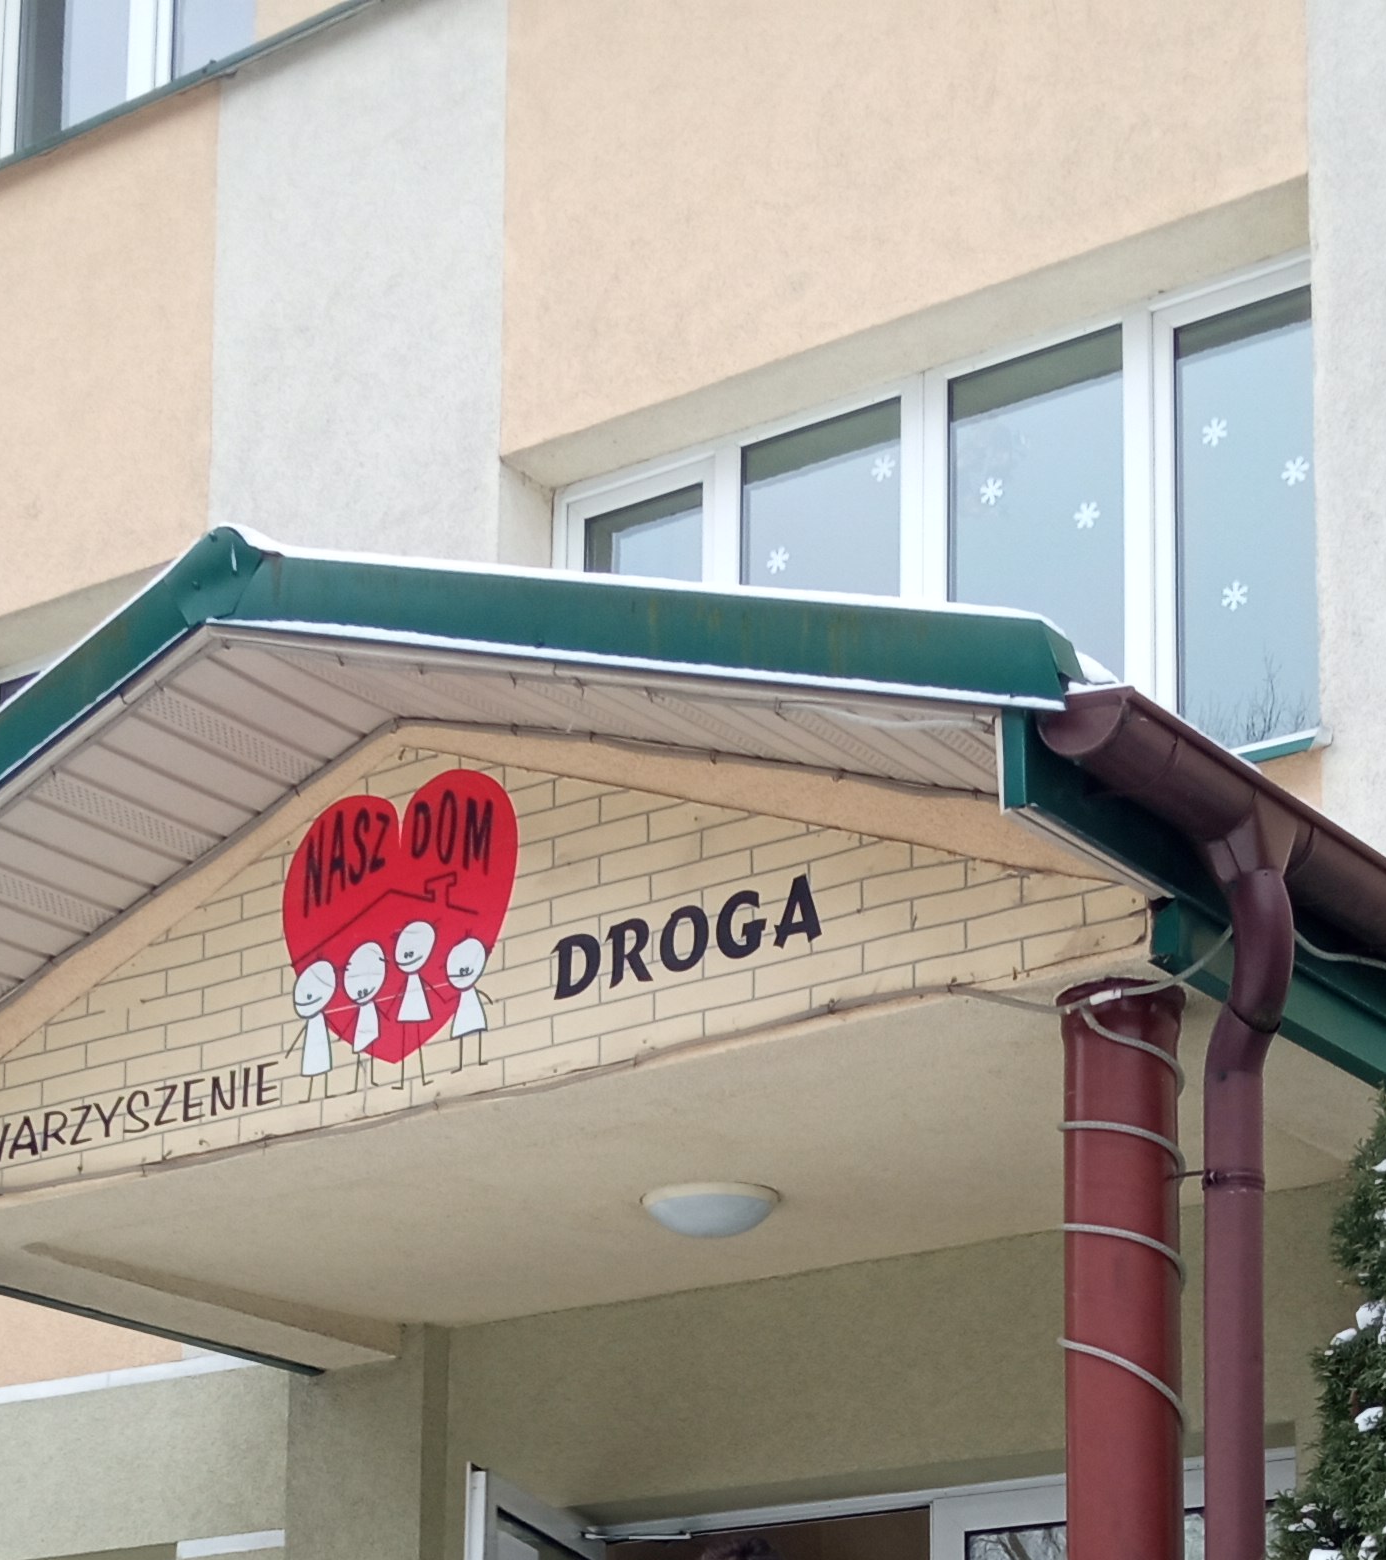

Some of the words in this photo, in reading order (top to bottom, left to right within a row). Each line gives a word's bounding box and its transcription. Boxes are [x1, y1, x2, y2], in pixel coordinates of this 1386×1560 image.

[303, 810, 391, 914] NASZ
[411, 790, 494, 870] DOM
[552, 873, 822, 1000] DROGA
